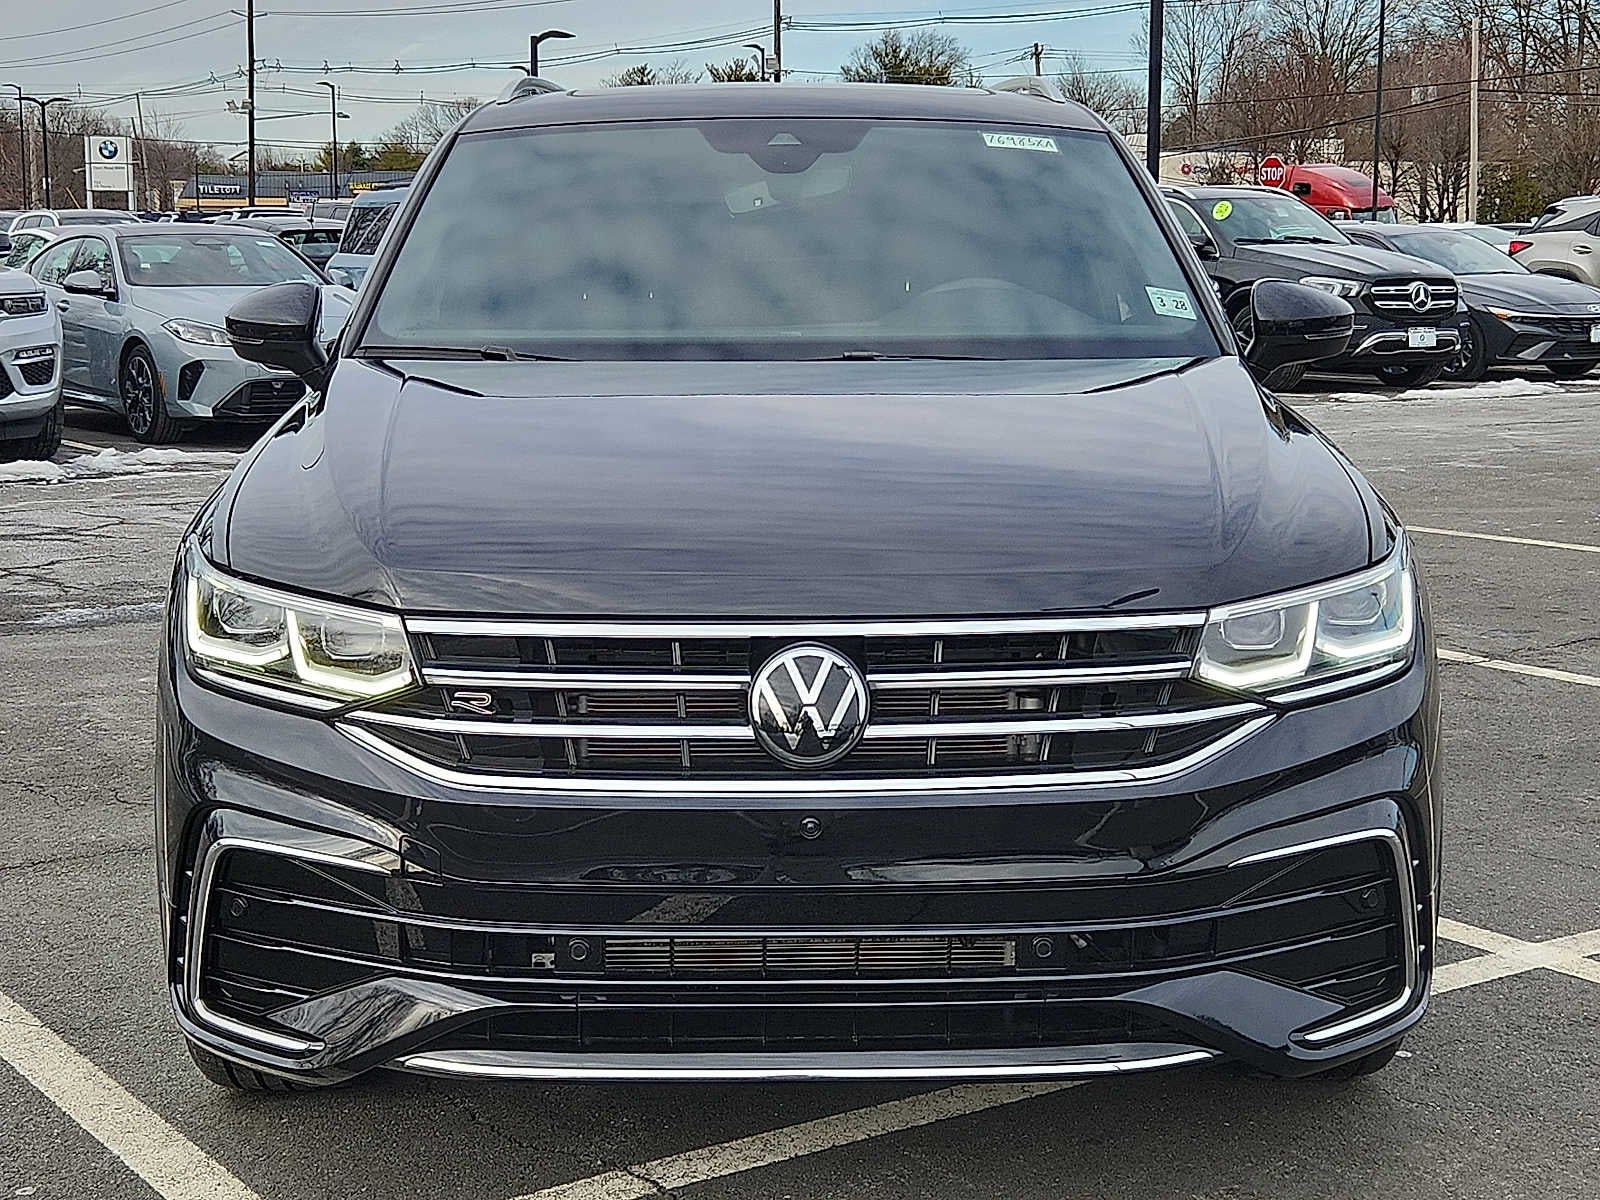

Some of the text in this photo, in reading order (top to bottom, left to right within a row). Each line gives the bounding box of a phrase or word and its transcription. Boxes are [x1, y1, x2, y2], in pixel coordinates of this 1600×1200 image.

[1260, 167, 1284, 181] STOP
[1156, 296, 1188, 311] 3 28
